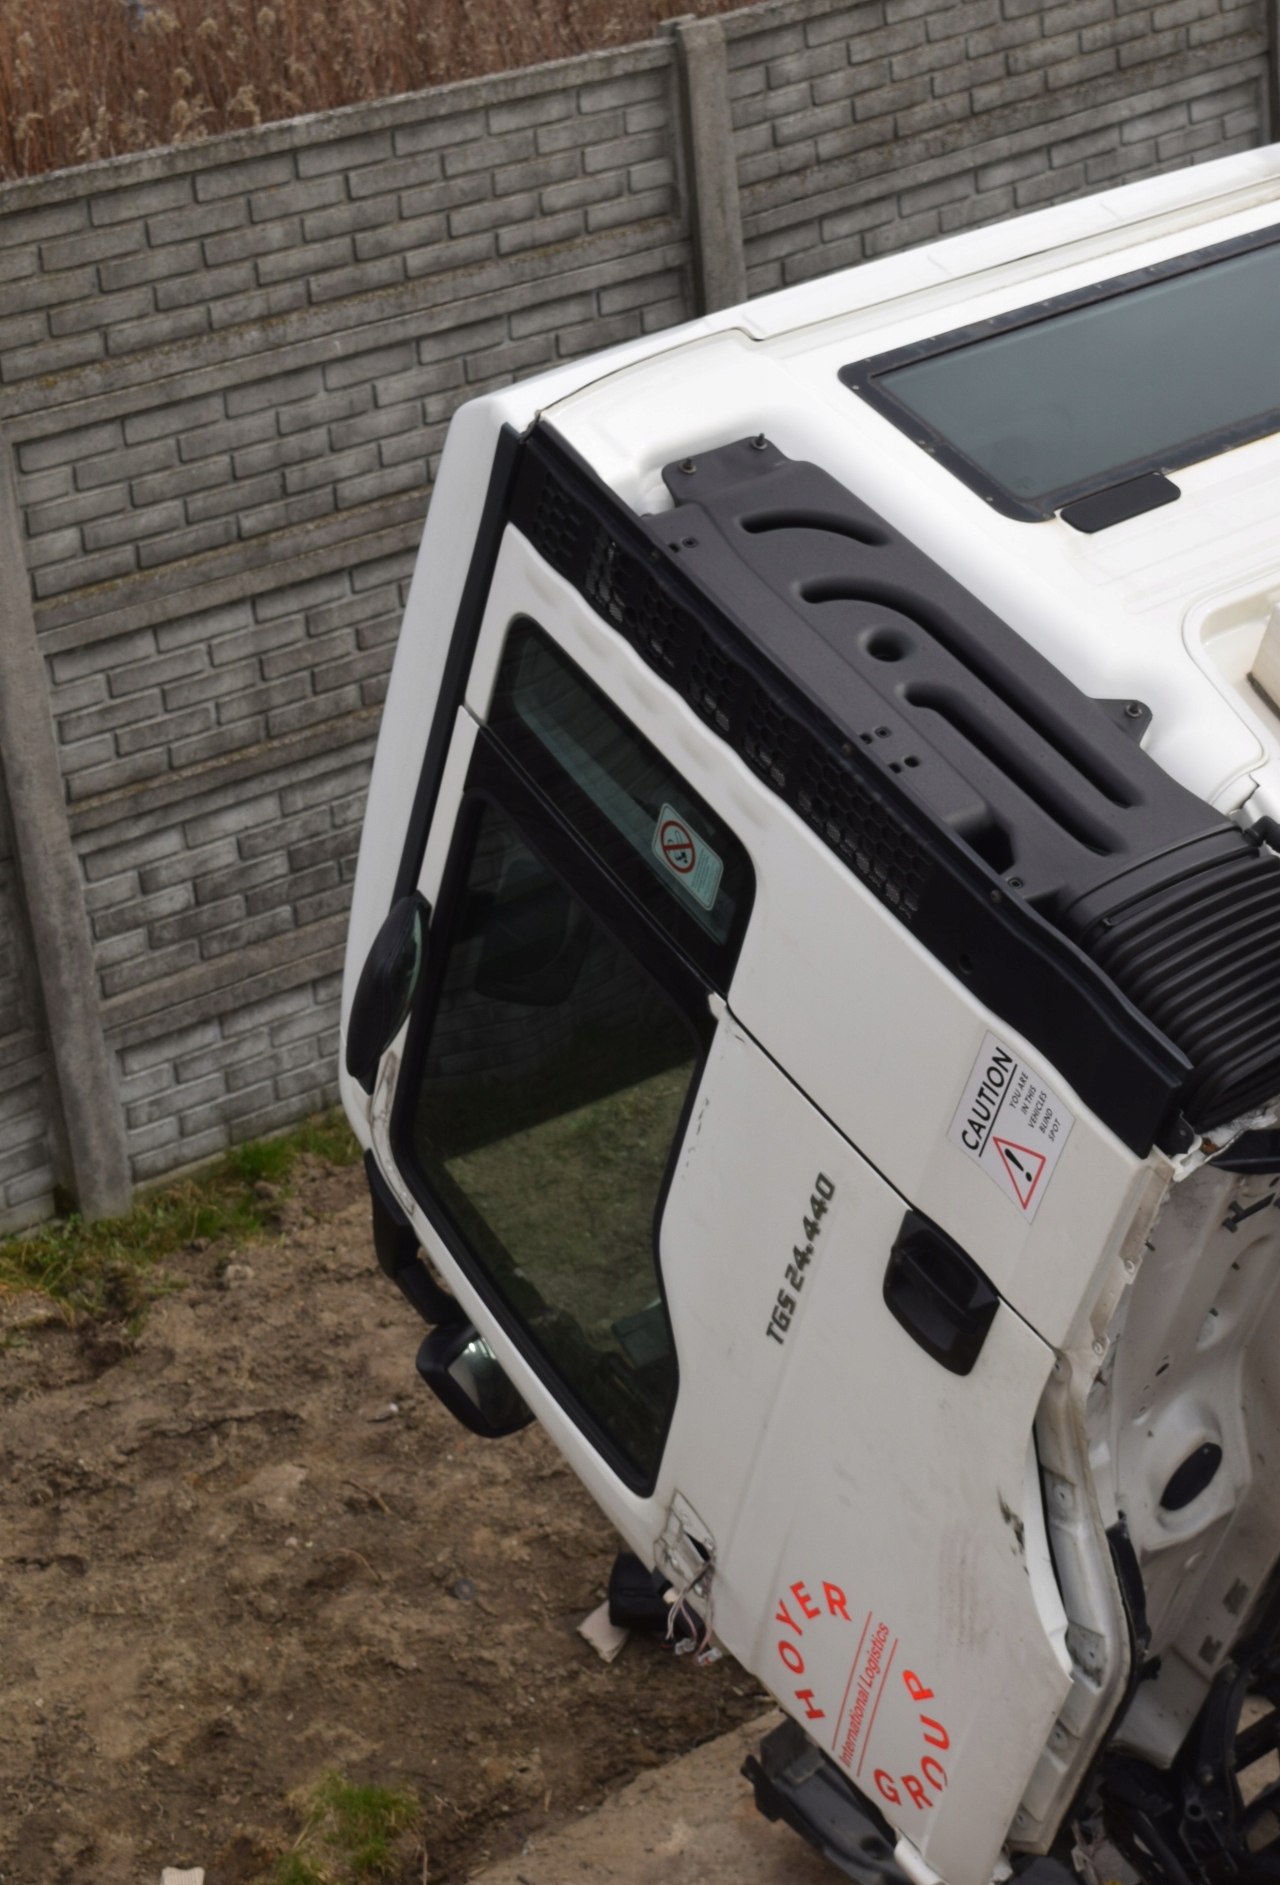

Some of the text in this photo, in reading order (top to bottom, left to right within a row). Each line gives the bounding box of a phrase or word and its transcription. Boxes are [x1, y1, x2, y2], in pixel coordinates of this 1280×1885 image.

[961, 1046, 1013, 1151] CAUTION
[1009, 1071, 1029, 1109] YOU ARE
[1020, 1084, 1037, 1115] IN THIS
[1027, 1090, 1047, 1129] VEHICLES
[1039, 1108, 1053, 1134] BLIND
[1048, 1118, 1061, 1142] SPOT
[766, 1171, 836, 1345] TGS 24.440
[775, 1581, 853, 1720] HOYER
[838, 1621, 890, 1768] International Logistics
[873, 1669, 950, 1810] GROUP
